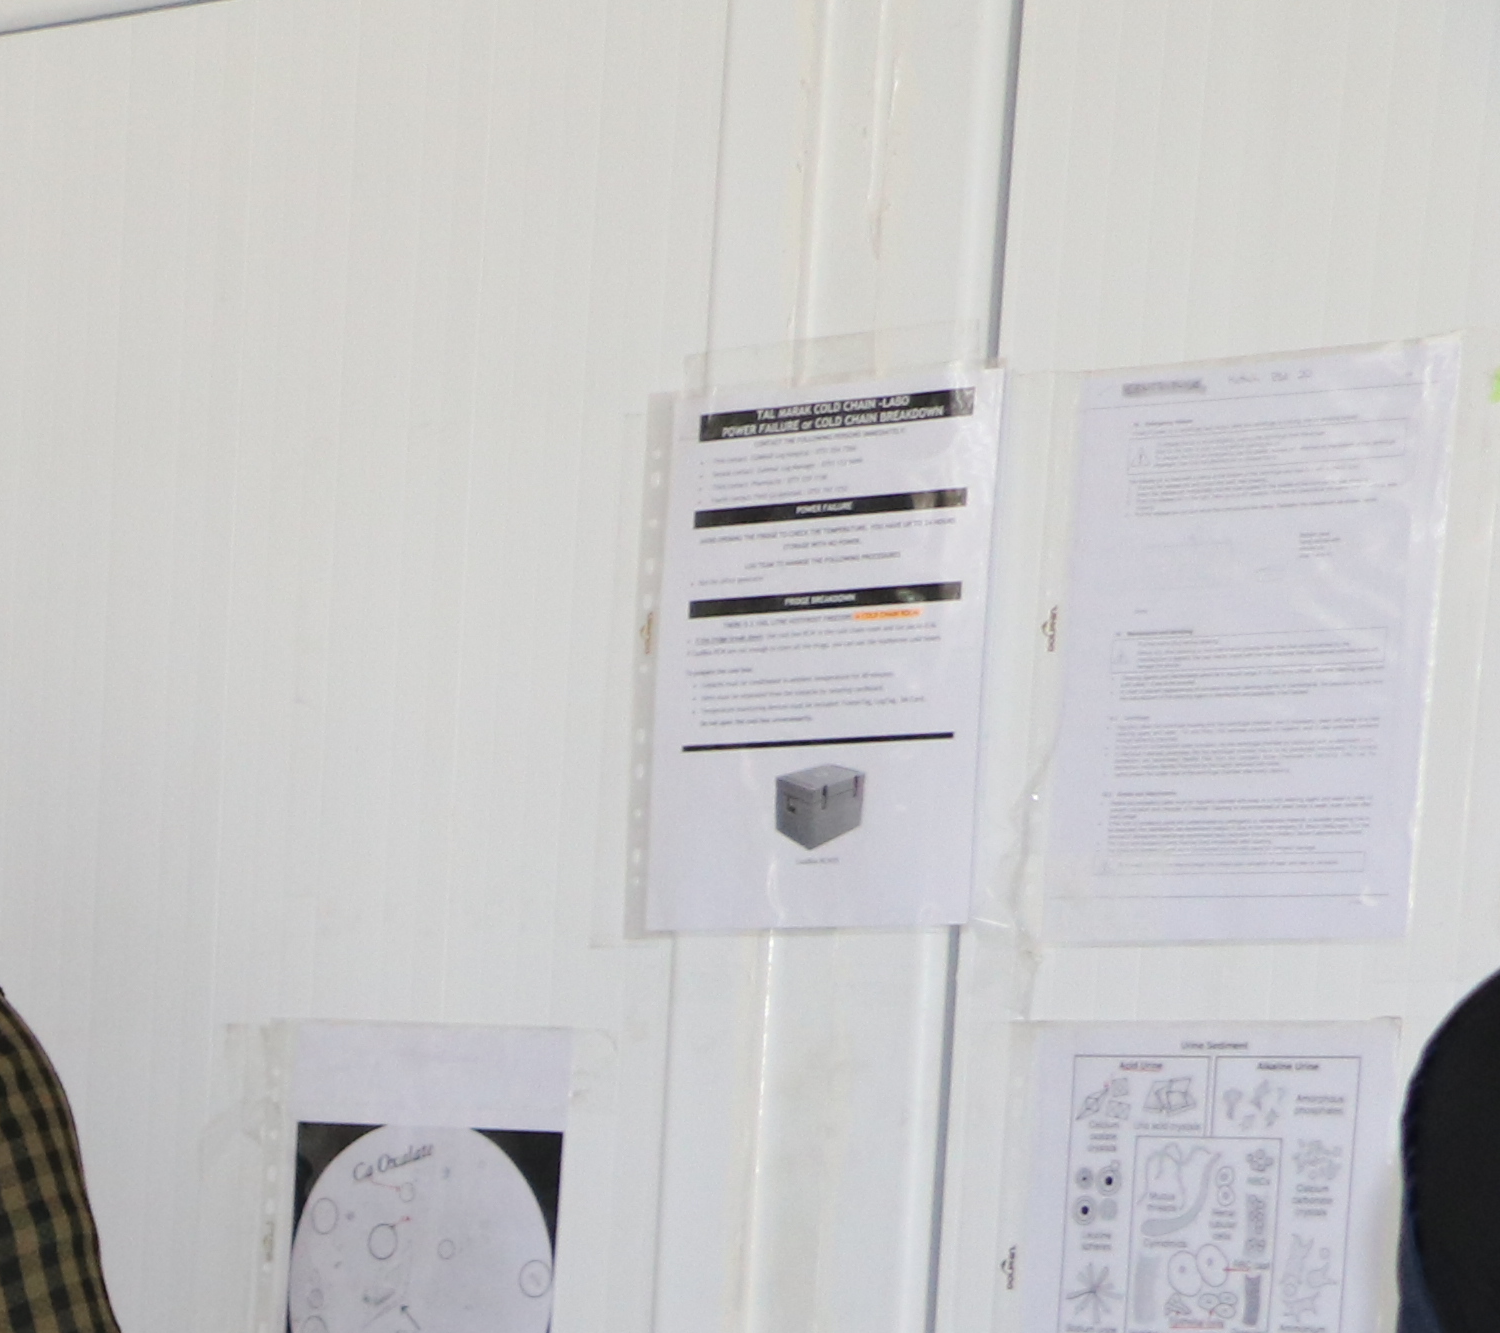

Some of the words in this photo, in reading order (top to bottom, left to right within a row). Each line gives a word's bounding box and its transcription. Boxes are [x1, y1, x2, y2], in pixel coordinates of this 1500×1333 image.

[757, 409, 776, 421] TAL
[814, 402, 840, 415] COLD
[843, 398, 877, 412] CHAIN
[721, 424, 756, 438] POWER
[758, 419, 799, 435] FAILURE
[801, 420, 812, 430] or
[815, 415, 842, 429] COLD
[844, 411, 878, 426] CHAIN
[880, 405, 944, 423] BREAKDOWN
[796, 503, 820, 515] POWER
